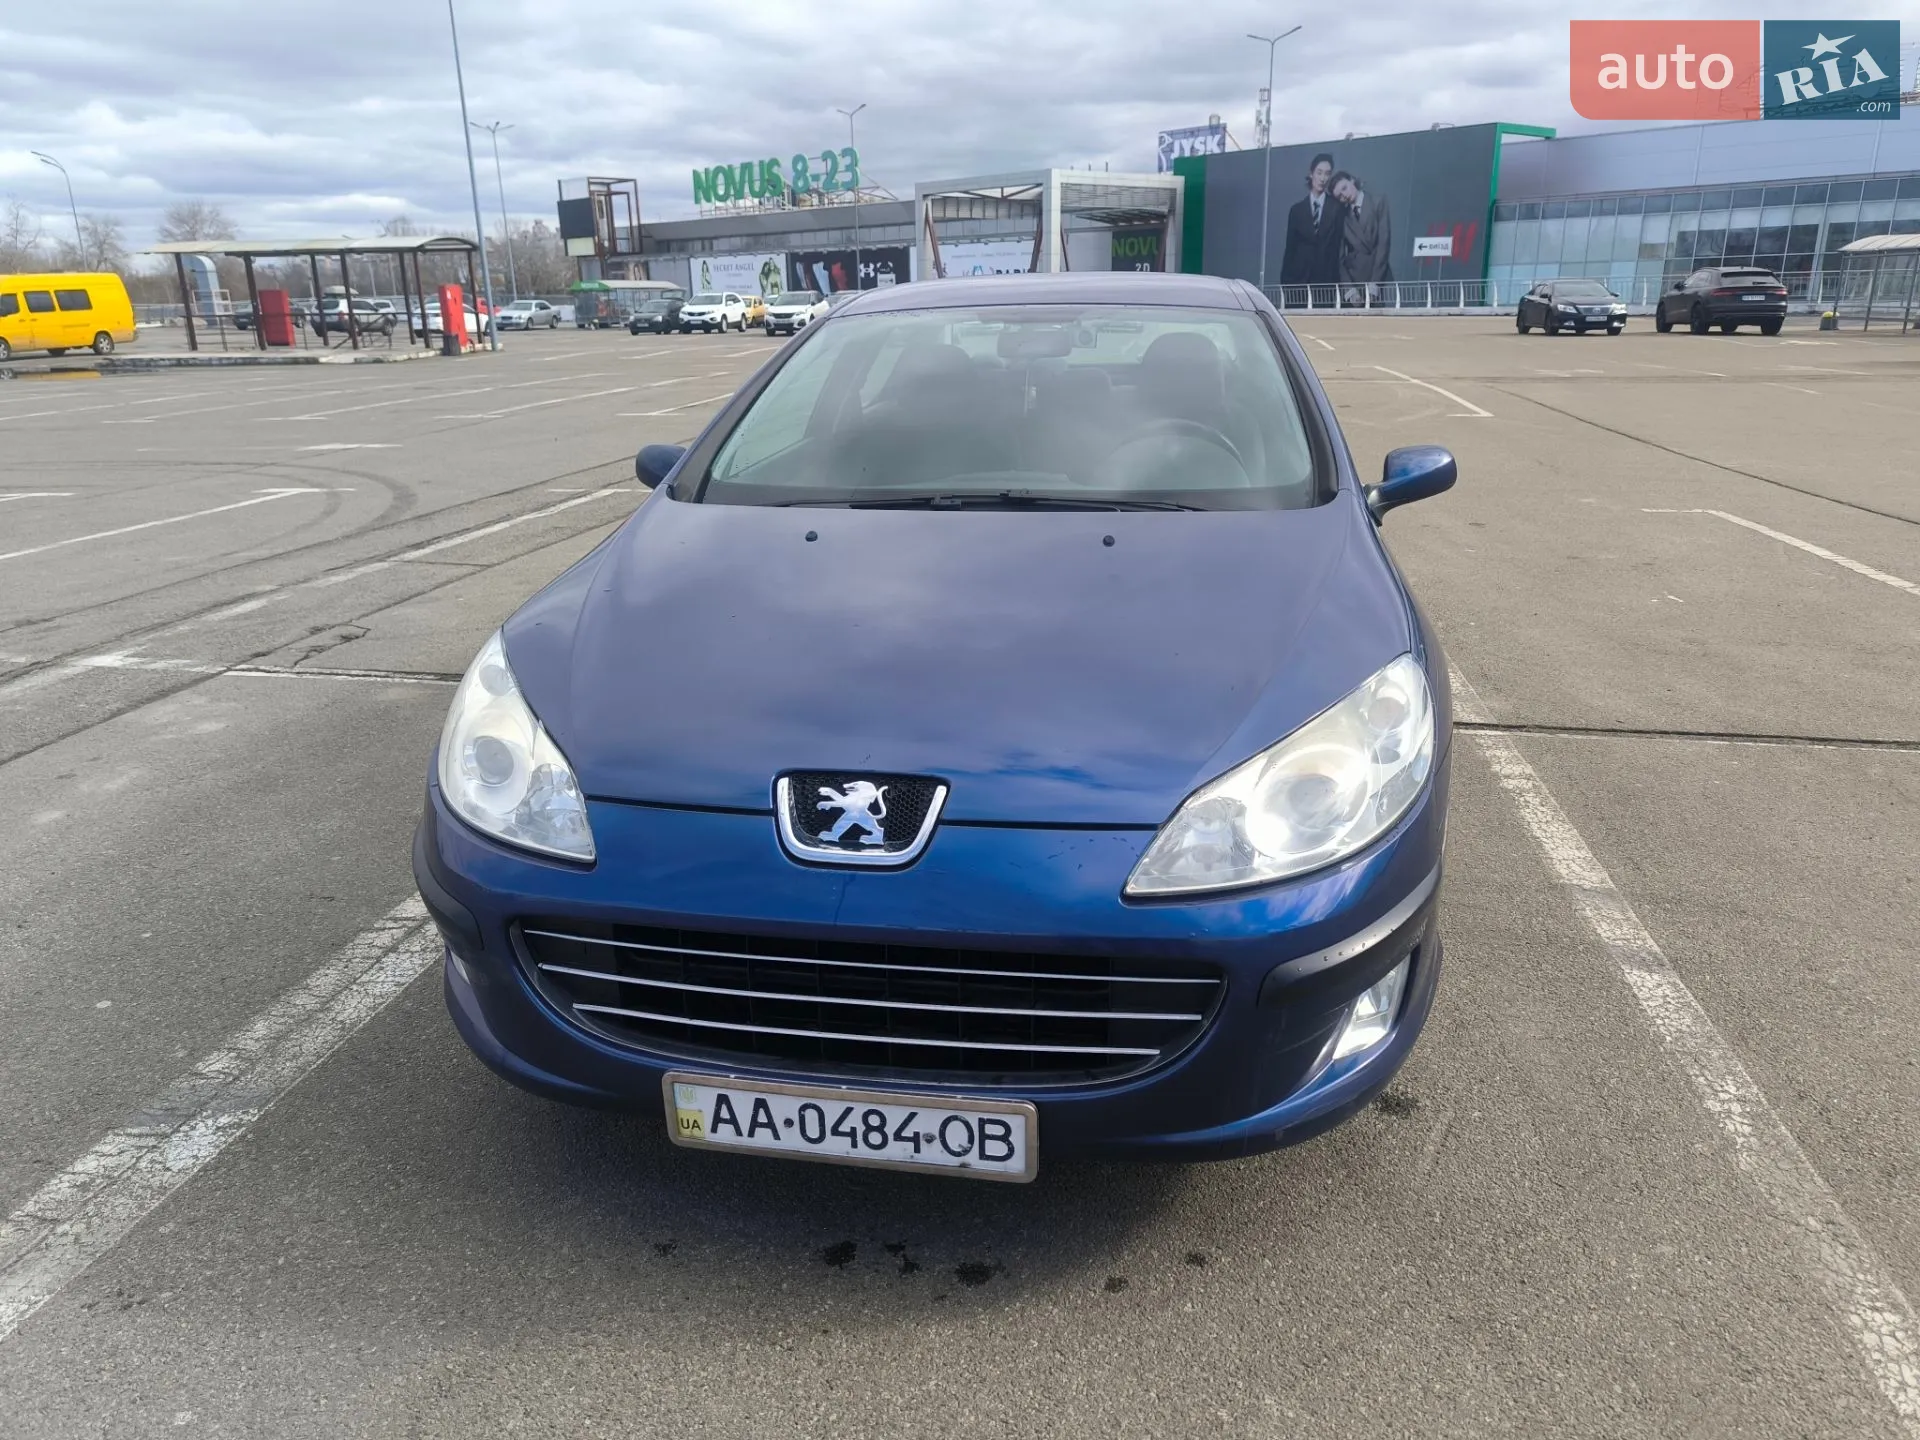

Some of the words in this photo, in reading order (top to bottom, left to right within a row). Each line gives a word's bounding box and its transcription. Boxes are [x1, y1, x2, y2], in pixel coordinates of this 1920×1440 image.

[1170, 134, 1221, 160] JYSK
[692, 156, 784, 204] NOVUS
[791, 147, 860, 193] 8-23
[680, 1116, 702, 1133] UA
